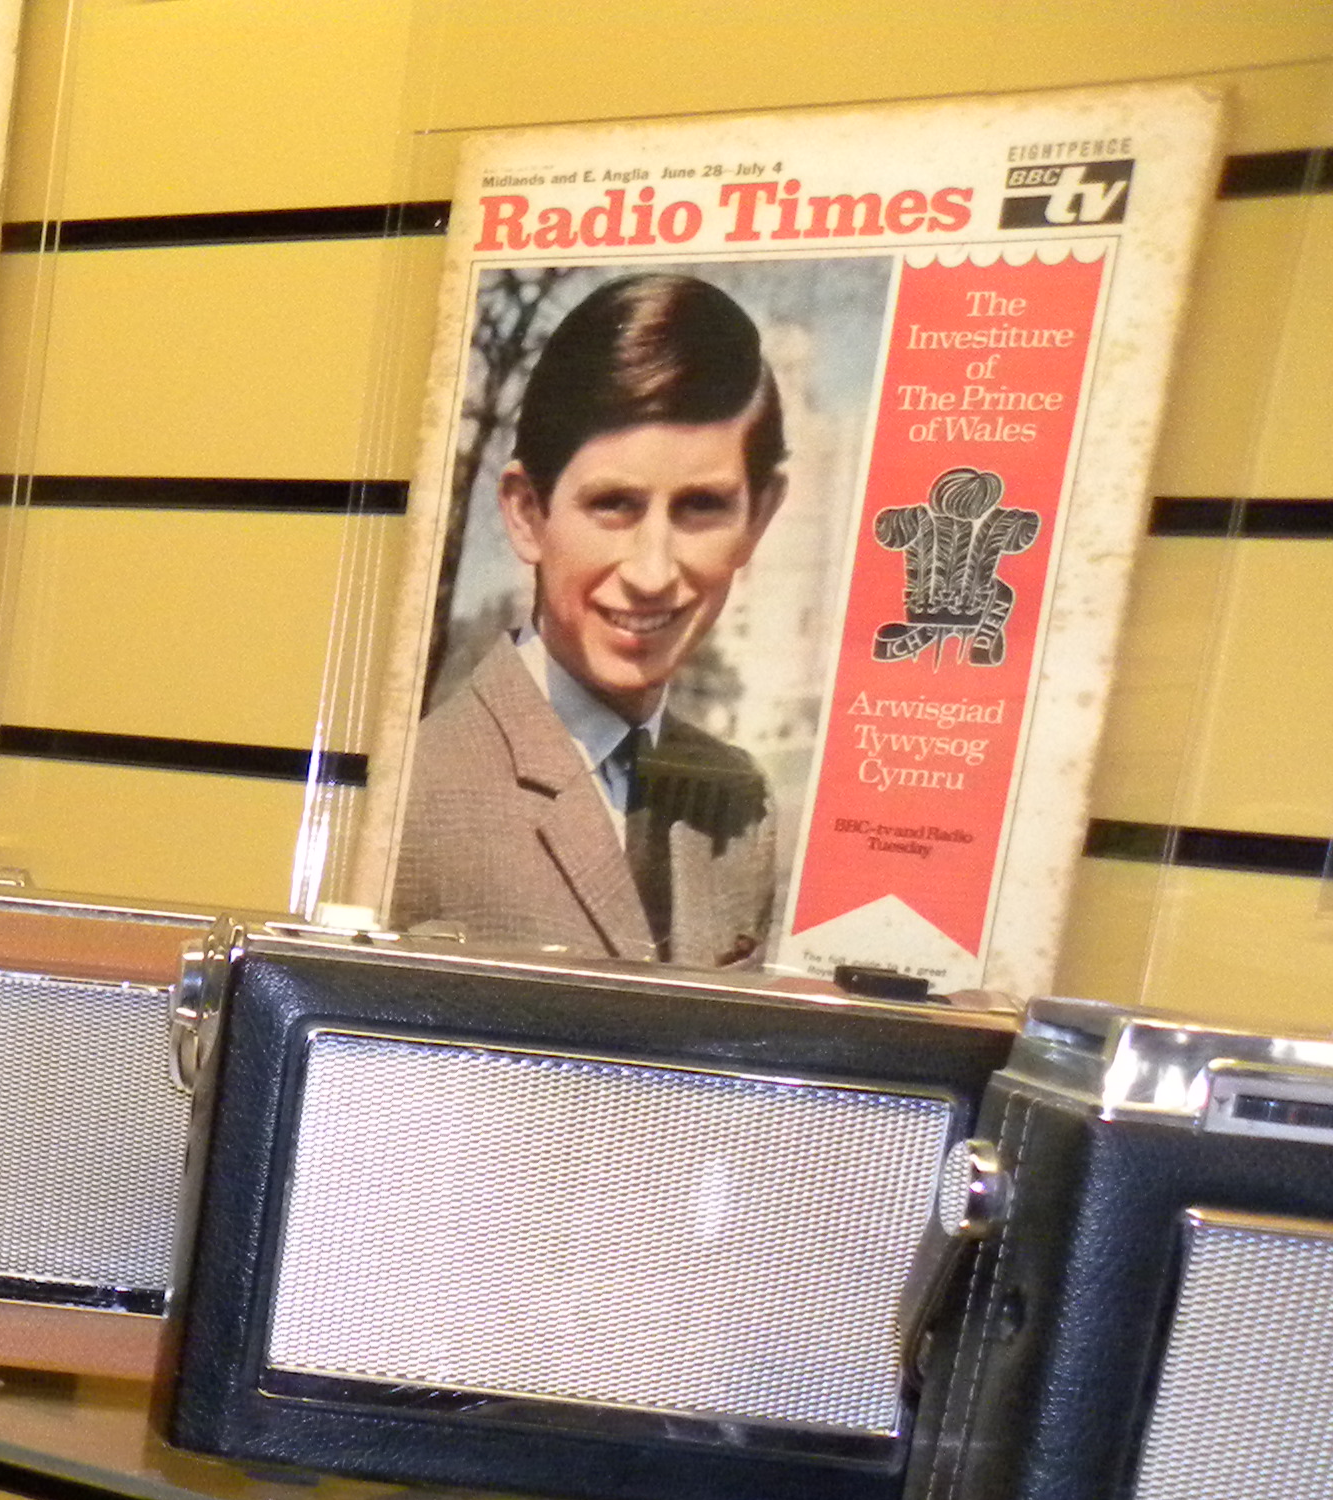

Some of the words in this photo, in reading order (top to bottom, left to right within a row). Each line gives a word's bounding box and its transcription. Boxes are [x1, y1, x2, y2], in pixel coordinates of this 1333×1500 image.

[1007, 138, 1132, 162] EIGHTPENCE
[483, 174, 545, 188] Midlands
[551, 172, 577, 185] and
[583, 170, 596, 183] E.
[602, 168, 649, 183] Anglia
[661, 165, 695, 180] June
[772, 161, 783, 174] 4
[1008, 168, 1061, 187] BBC
[1044, 166, 1128, 224] tv
[473, 186, 703, 251] Radio
[719, 179, 974, 242] Times
[965, 291, 1027, 317] The
[906, 323, 1074, 350] Investiture
[966, 354, 1000, 380] of
[897, 385, 955, 411] The
[960, 385, 1063, 412] Prince
[908, 417, 942, 443] of
[943, 416, 1037, 443] Wales
[974, 599, 1010, 651] DIEN
[886, 636, 923, 657] ICH
[847, 690, 1005, 729] Arwisgiad
[854, 723, 989, 766] Tywysog
[858, 757, 965, 792] Cymru
[834, 818, 891, 836] BBC-tv
[893, 824, 925, 839] and
[926, 826, 974, 844] Radio
[867, 836, 933, 860] Tuesday
[803, 951, 822, 963] The
[904, 965, 911, 973] a
[917, 966, 947, 977] great
